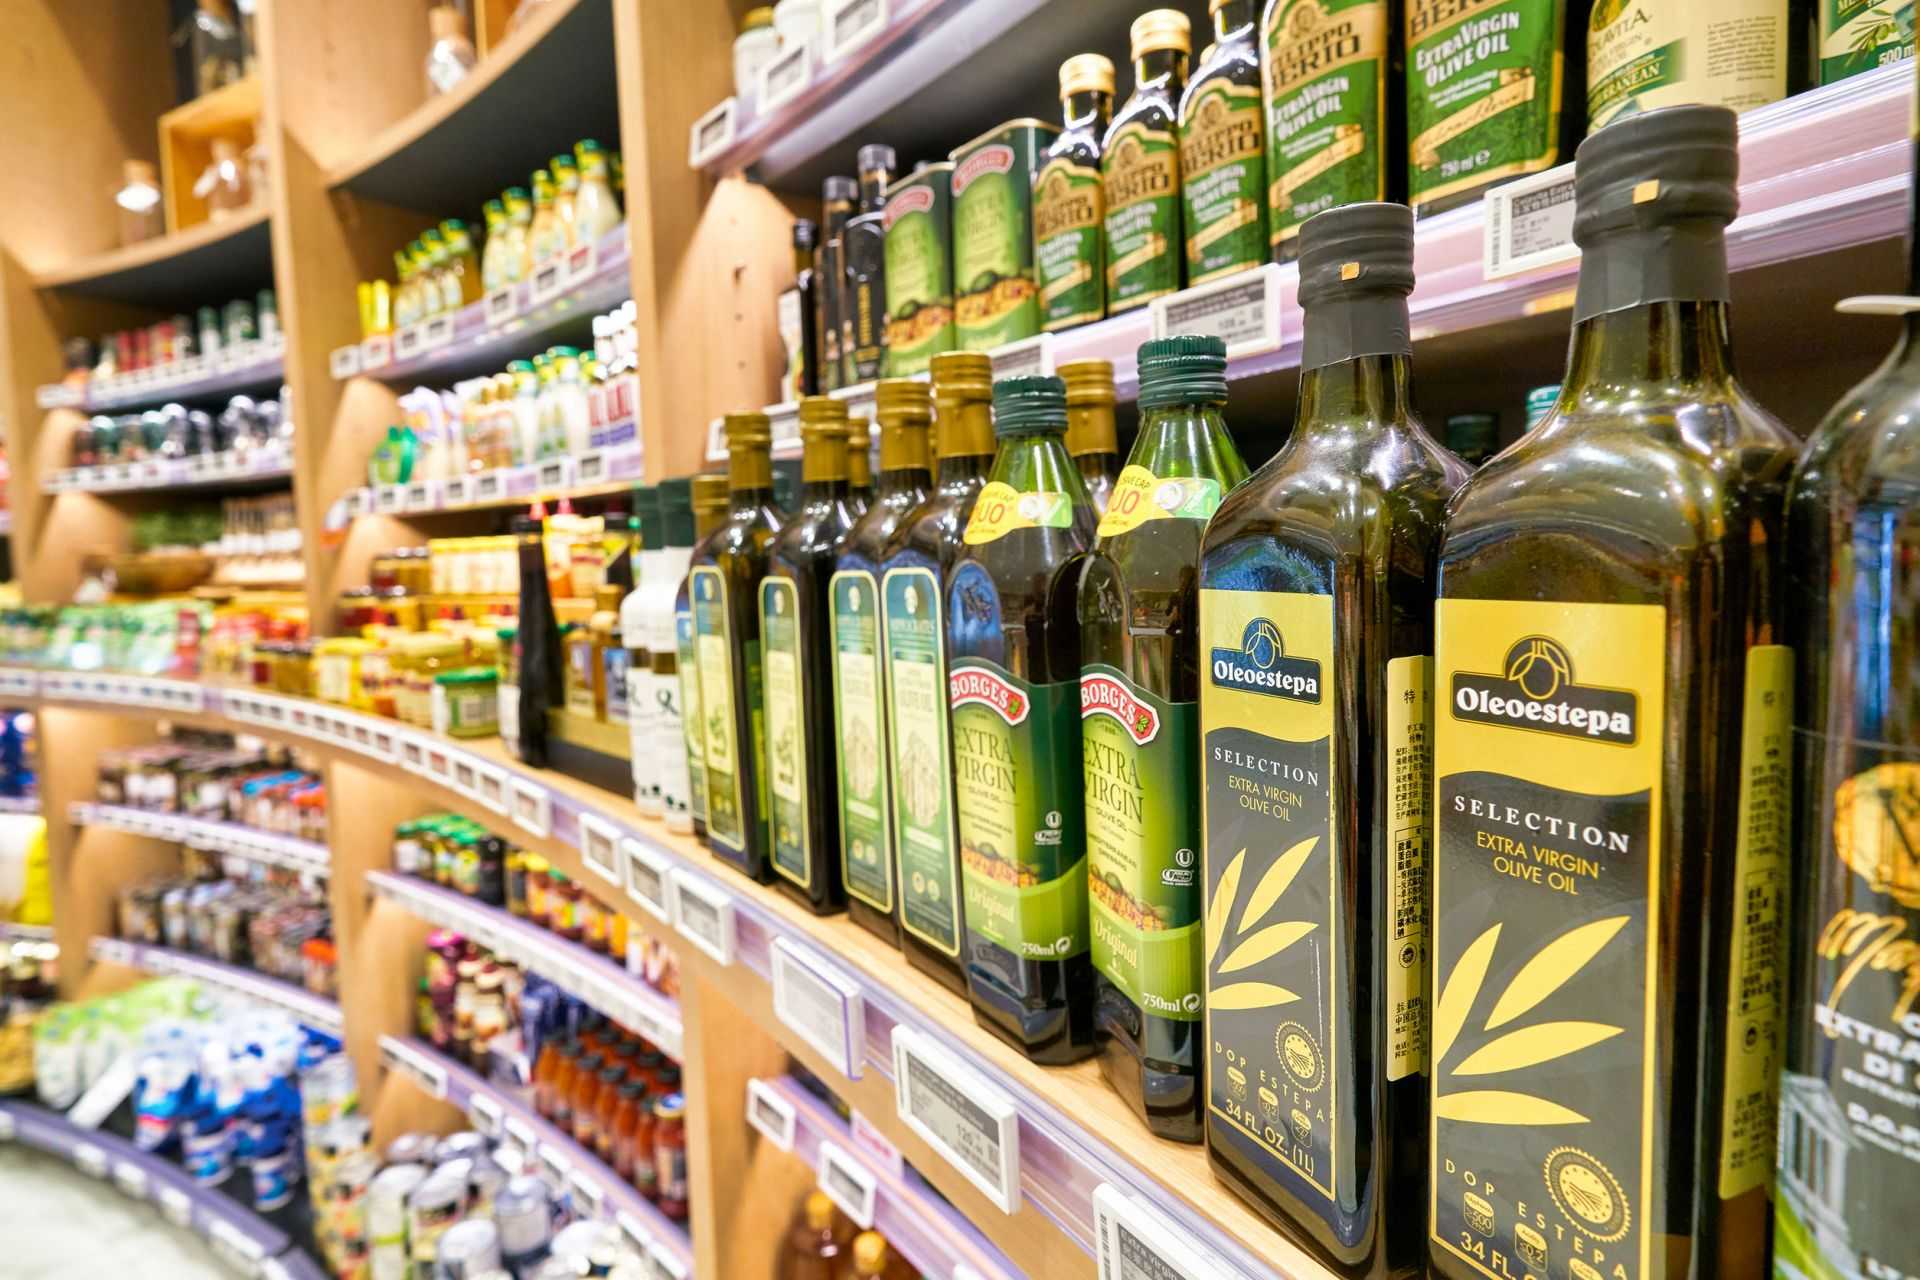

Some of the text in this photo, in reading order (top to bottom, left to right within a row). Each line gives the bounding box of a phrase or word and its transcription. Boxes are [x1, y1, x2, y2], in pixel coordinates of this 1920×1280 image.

[1425, 33, 1510, 87] OLIVE OIL
[951, 675, 1009, 710] BORGES
[1214, 659, 1319, 696] Oleoestepa
[1081, 677, 1136, 726] BORGES
[1456, 687, 1632, 735] Oleoestepa
[1214, 746, 1320, 787] SELECTION
[1228, 774, 1303, 809] EXTRA VIRGIN
[1239, 795, 1291, 823] OLIVE OIL
[1454, 794, 1630, 854] SELECTION
[1476, 831, 1599, 879] EXTRA VIRGIN
[1493, 856, 1580, 896] OLIVE OIL
[1022, 942, 1055, 956] 750ml
[1095, 917, 1137, 969] Original
[1143, 992, 1180, 1012] 750ml
[1226, 1099, 1314, 1177] 34 FL. OZ. (1L)
[1460, 1231, 1489, 1261] 34
